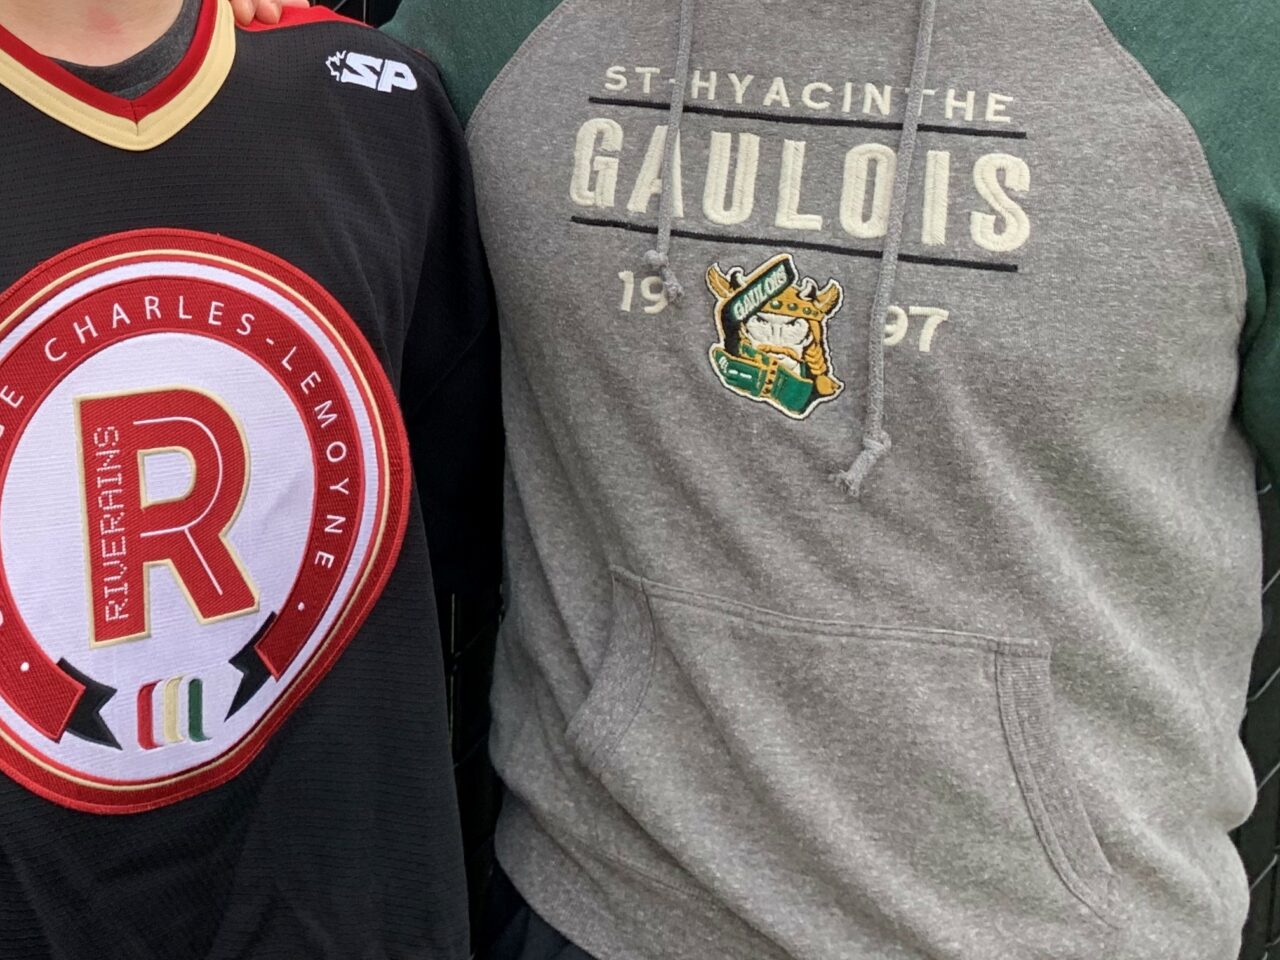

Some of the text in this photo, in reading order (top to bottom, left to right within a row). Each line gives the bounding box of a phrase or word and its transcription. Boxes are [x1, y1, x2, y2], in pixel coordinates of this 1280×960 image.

[569, 117, 1032, 253] GAULOIS
[618, 270, 950, 352] 19 97
[733, 264, 787, 320] GAULOIS
[43, 295, 350, 570] CHARLES-LEMOYNE
[73, 385, 261, 651] R
[93, 425, 130, 623] RIVERAINS
